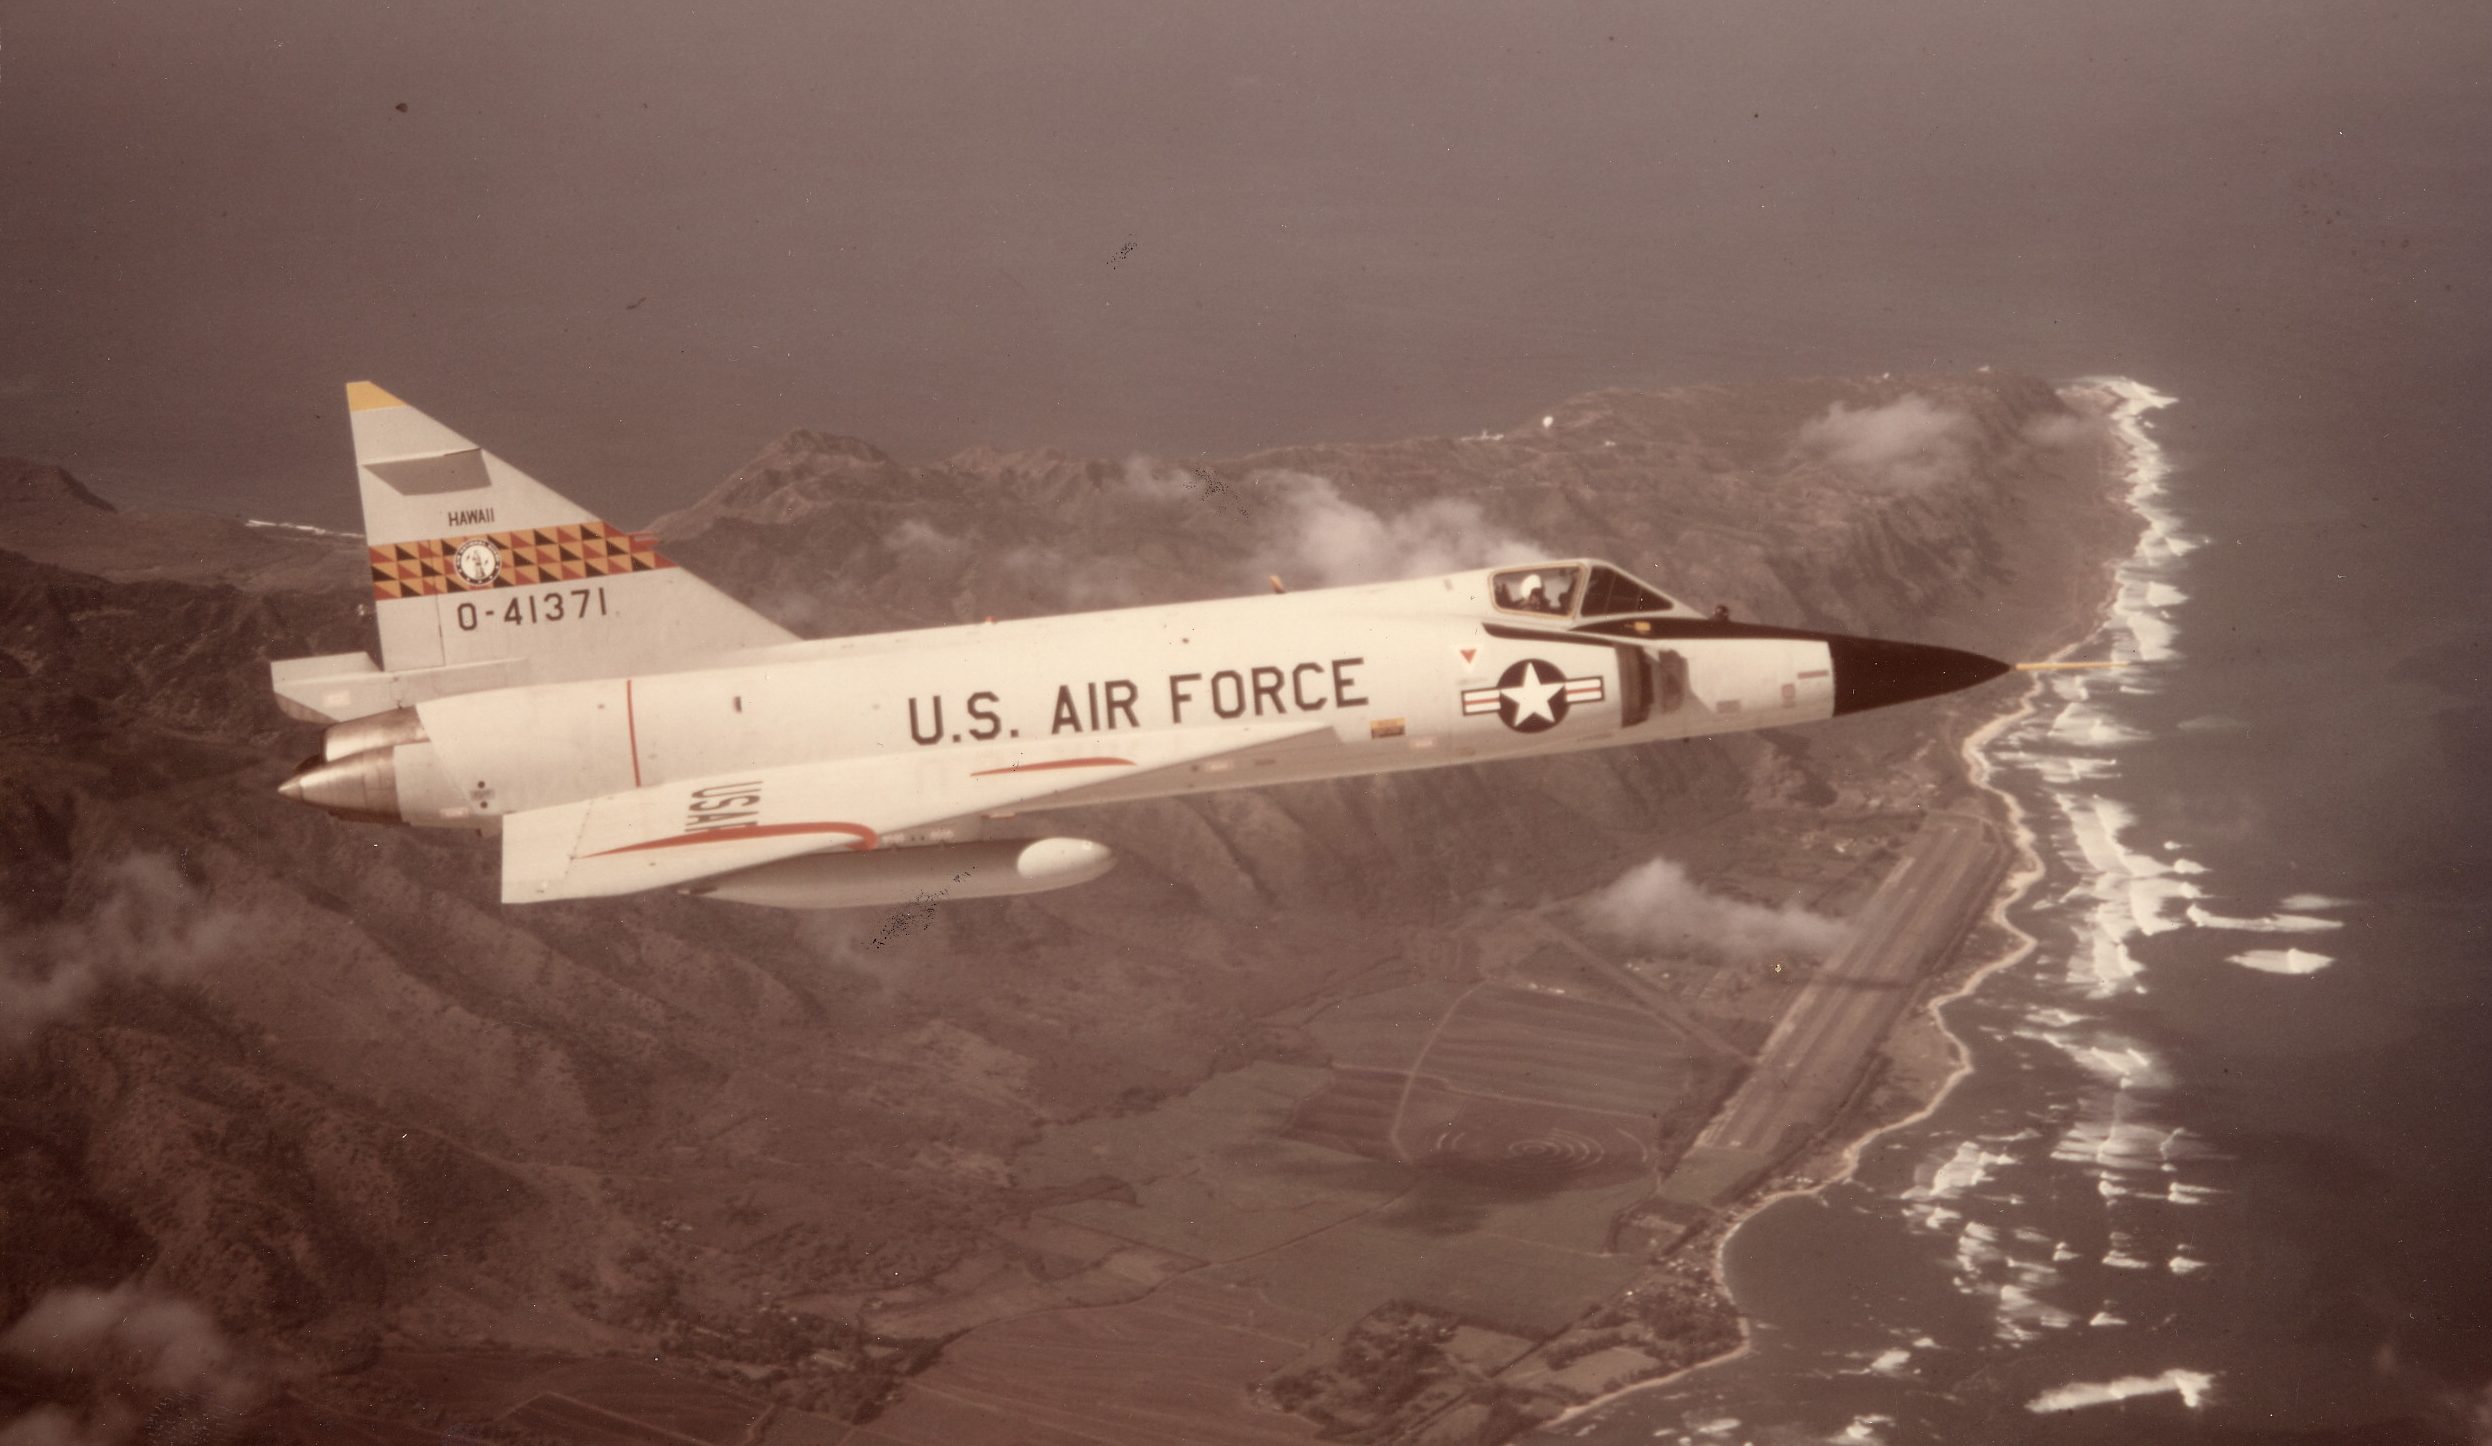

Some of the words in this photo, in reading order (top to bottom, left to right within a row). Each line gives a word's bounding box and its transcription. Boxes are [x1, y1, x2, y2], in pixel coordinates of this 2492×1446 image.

[448, 507, 495, 527] HAWAII
[908, 691, 1019, 746] U.S.
[1051, 679, 1140, 735] AIR
[1168, 657, 1369, 725] FORCE
